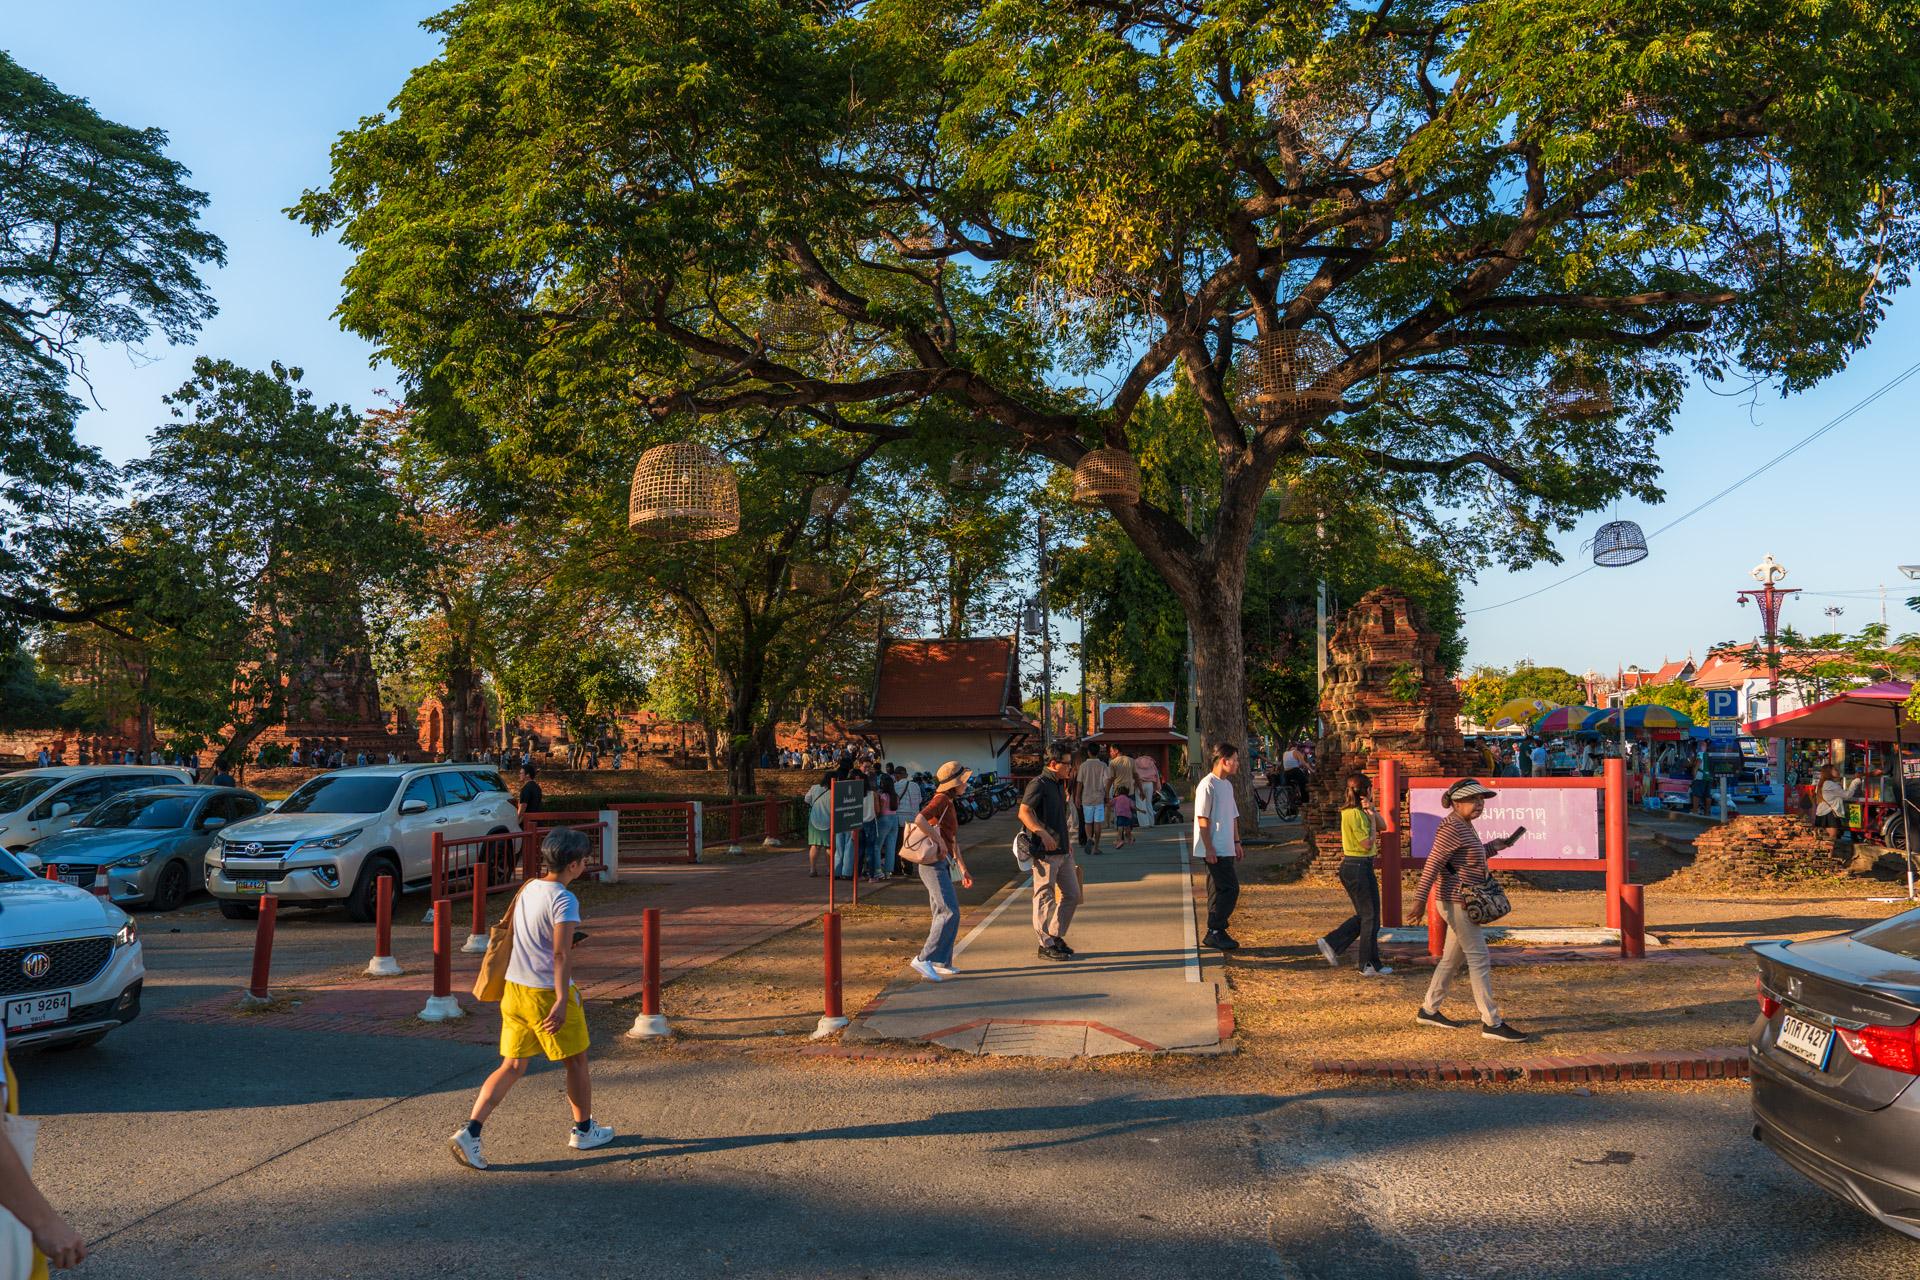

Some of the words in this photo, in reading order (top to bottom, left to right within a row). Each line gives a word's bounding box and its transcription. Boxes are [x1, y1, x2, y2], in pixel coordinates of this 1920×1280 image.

[1714, 692, 1732, 715] P
[1478, 807, 1546, 826] มหาธาตุ
[1486, 830, 1513, 840] Mah
[25, 953, 48, 976] MG
[38, 996, 66, 1012] 9264
[1802, 1024, 1827, 1049] 7427
